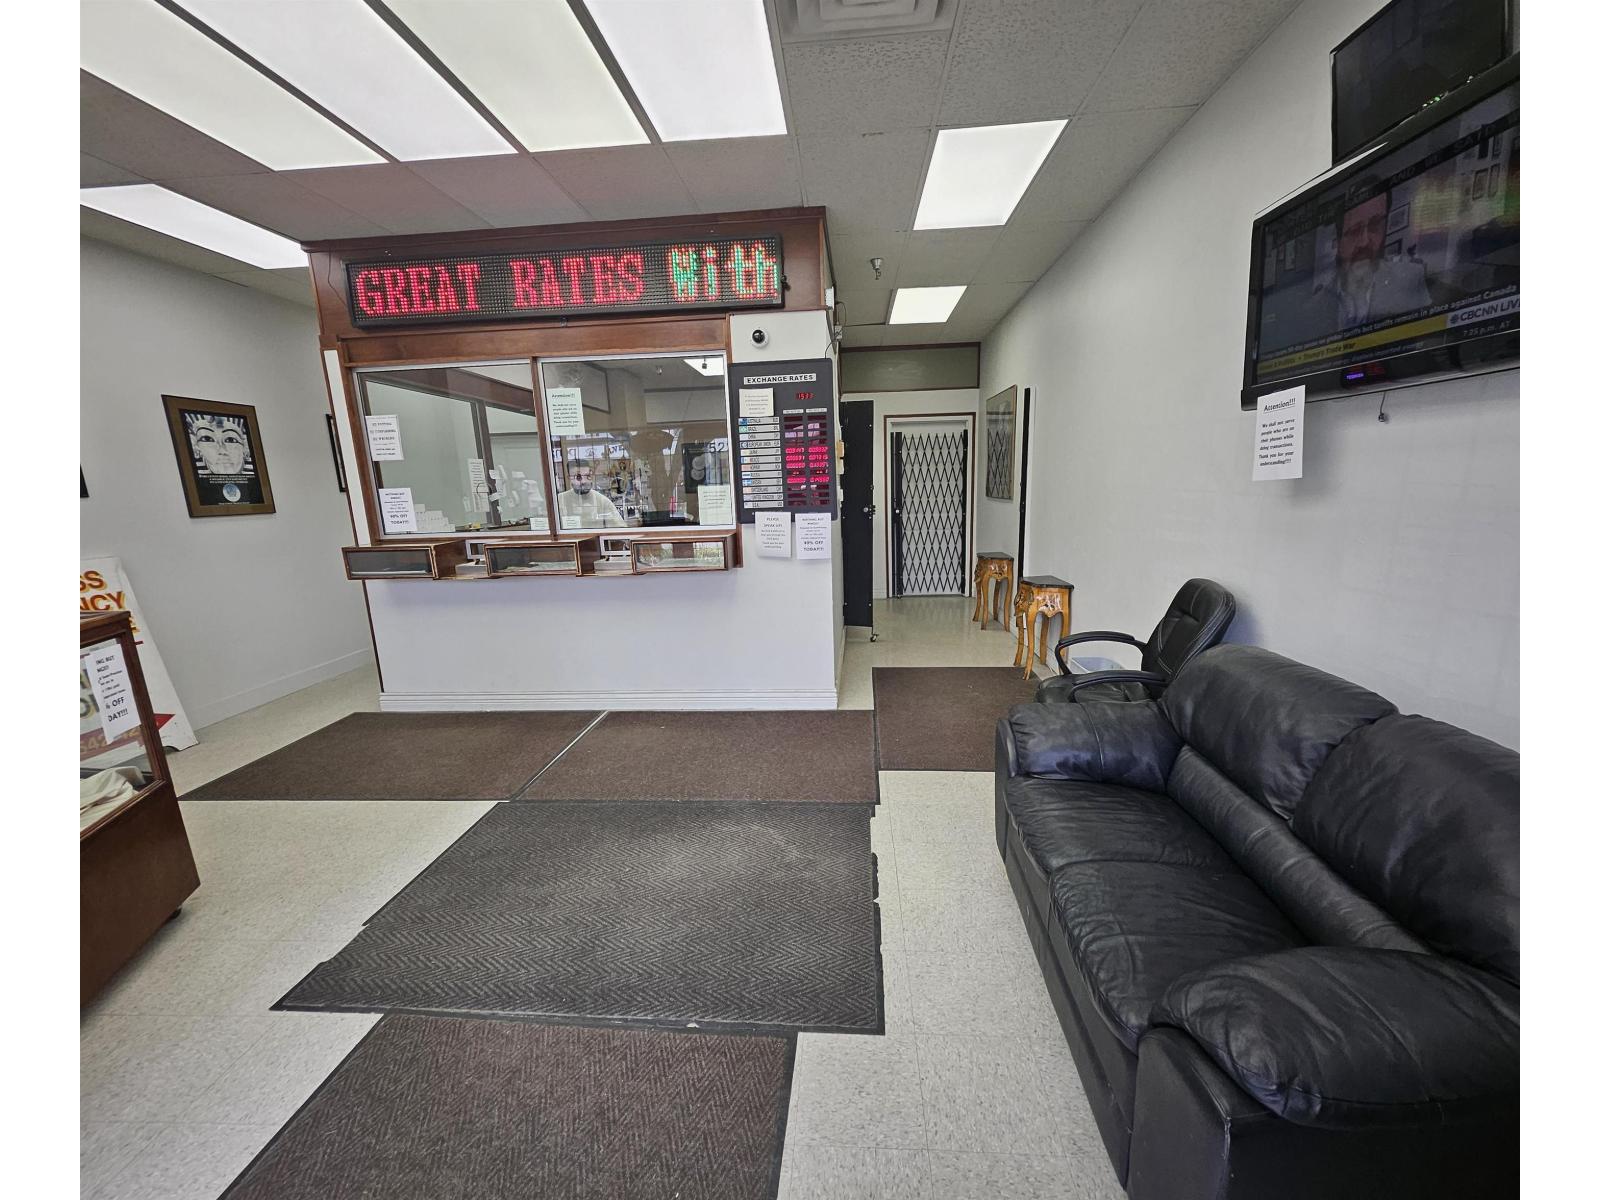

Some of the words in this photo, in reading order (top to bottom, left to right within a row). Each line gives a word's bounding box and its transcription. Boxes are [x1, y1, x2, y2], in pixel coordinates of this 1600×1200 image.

[356, 262, 481, 317] GREAT
[509, 251, 644, 309] RATES
[665, 240, 778, 303] With
[1483, 284, 1516, 300] Canada
[1460, 303, 1498, 321] CBCNN
[747, 375, 788, 384] EXCHANGE
[789, 374, 814, 382] RATES
[112, 696, 125, 708] OFF
